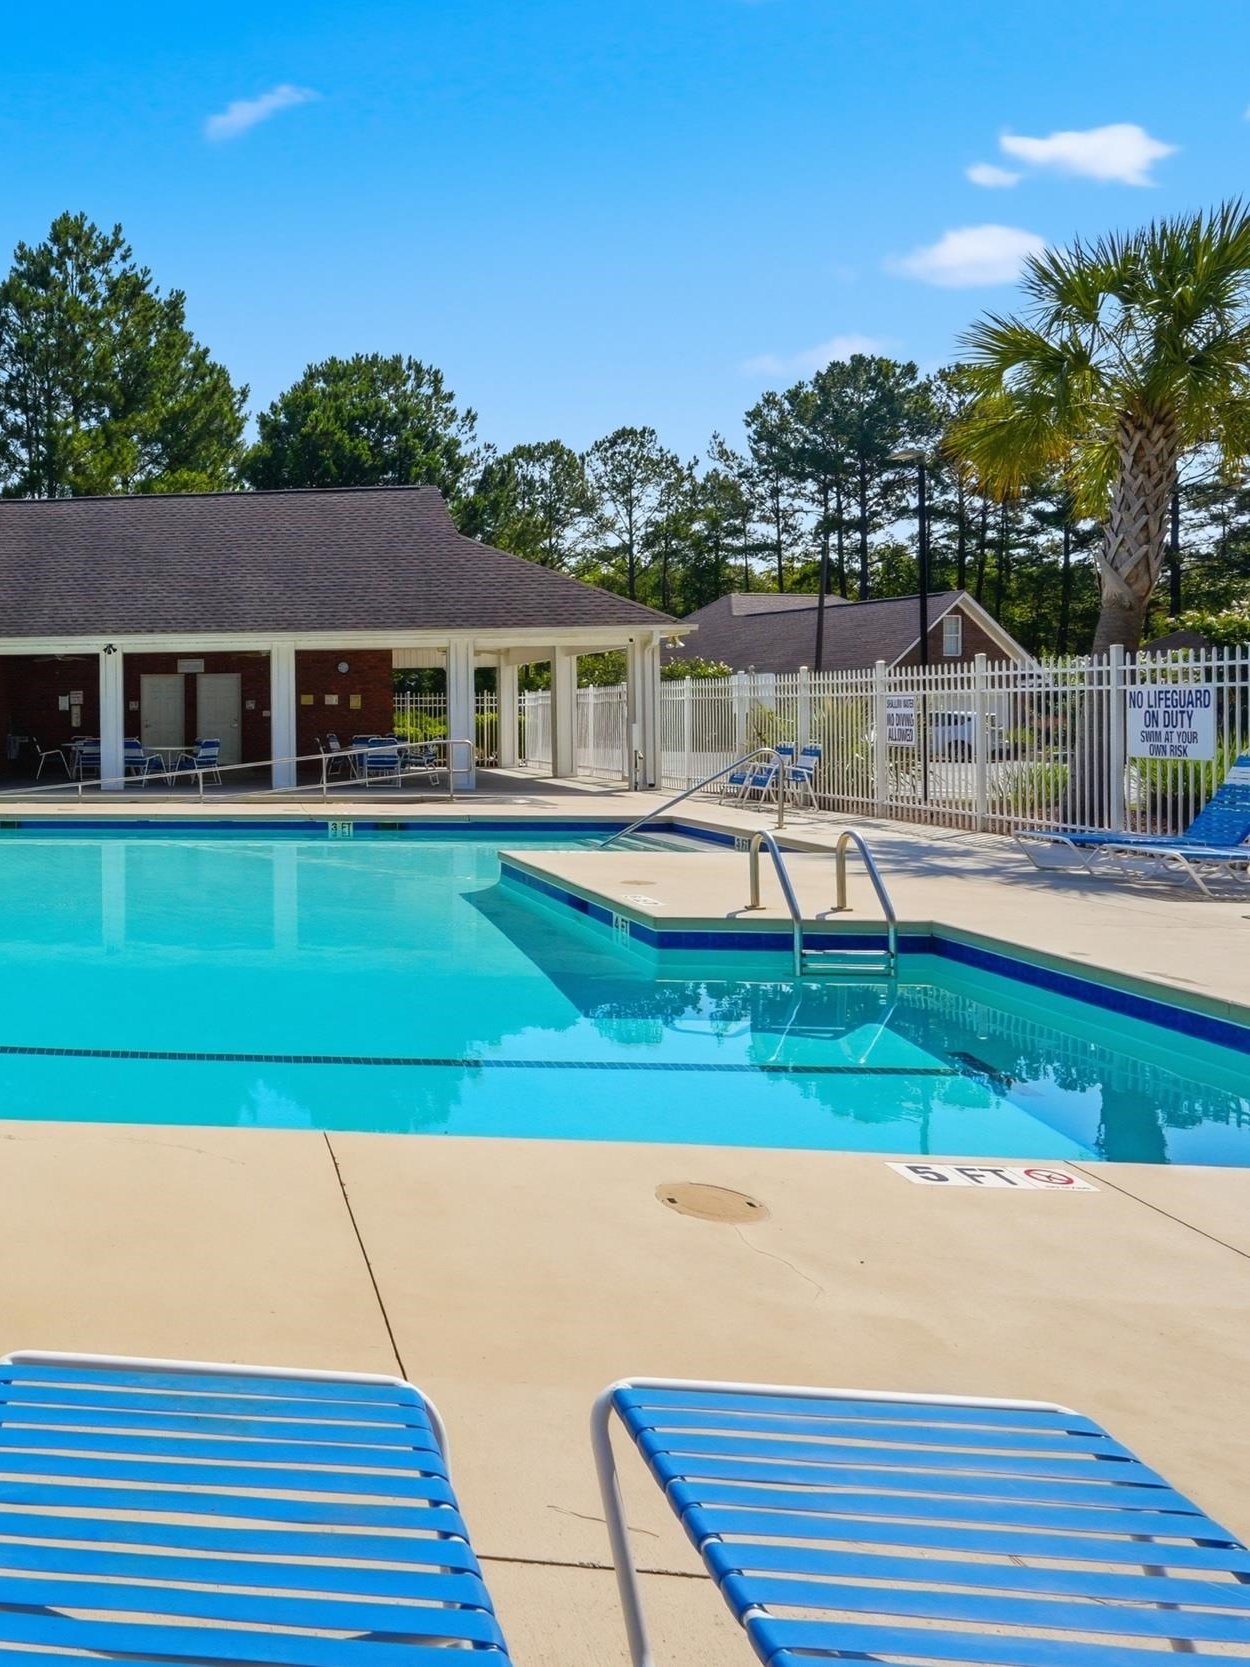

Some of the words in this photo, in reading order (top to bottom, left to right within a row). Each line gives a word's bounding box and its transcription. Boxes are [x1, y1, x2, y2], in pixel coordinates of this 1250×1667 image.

[1129, 690, 1143, 709] NO
[1147, 689, 1211, 709] LIFEGUARD
[1144, 710, 1159, 728] ON
[1163, 710, 1193, 729] DUTY
[1140, 730, 1162, 743] SWIM
[1164, 730, 1174, 743] AT
[1176, 731, 1198, 744] YOUR
[1149, 743, 1167, 756] OWN
[1169, 744, 1188, 757] RISK
[905, 1165, 949, 1182] 5
[955, 1167, 1018, 1186] FT
